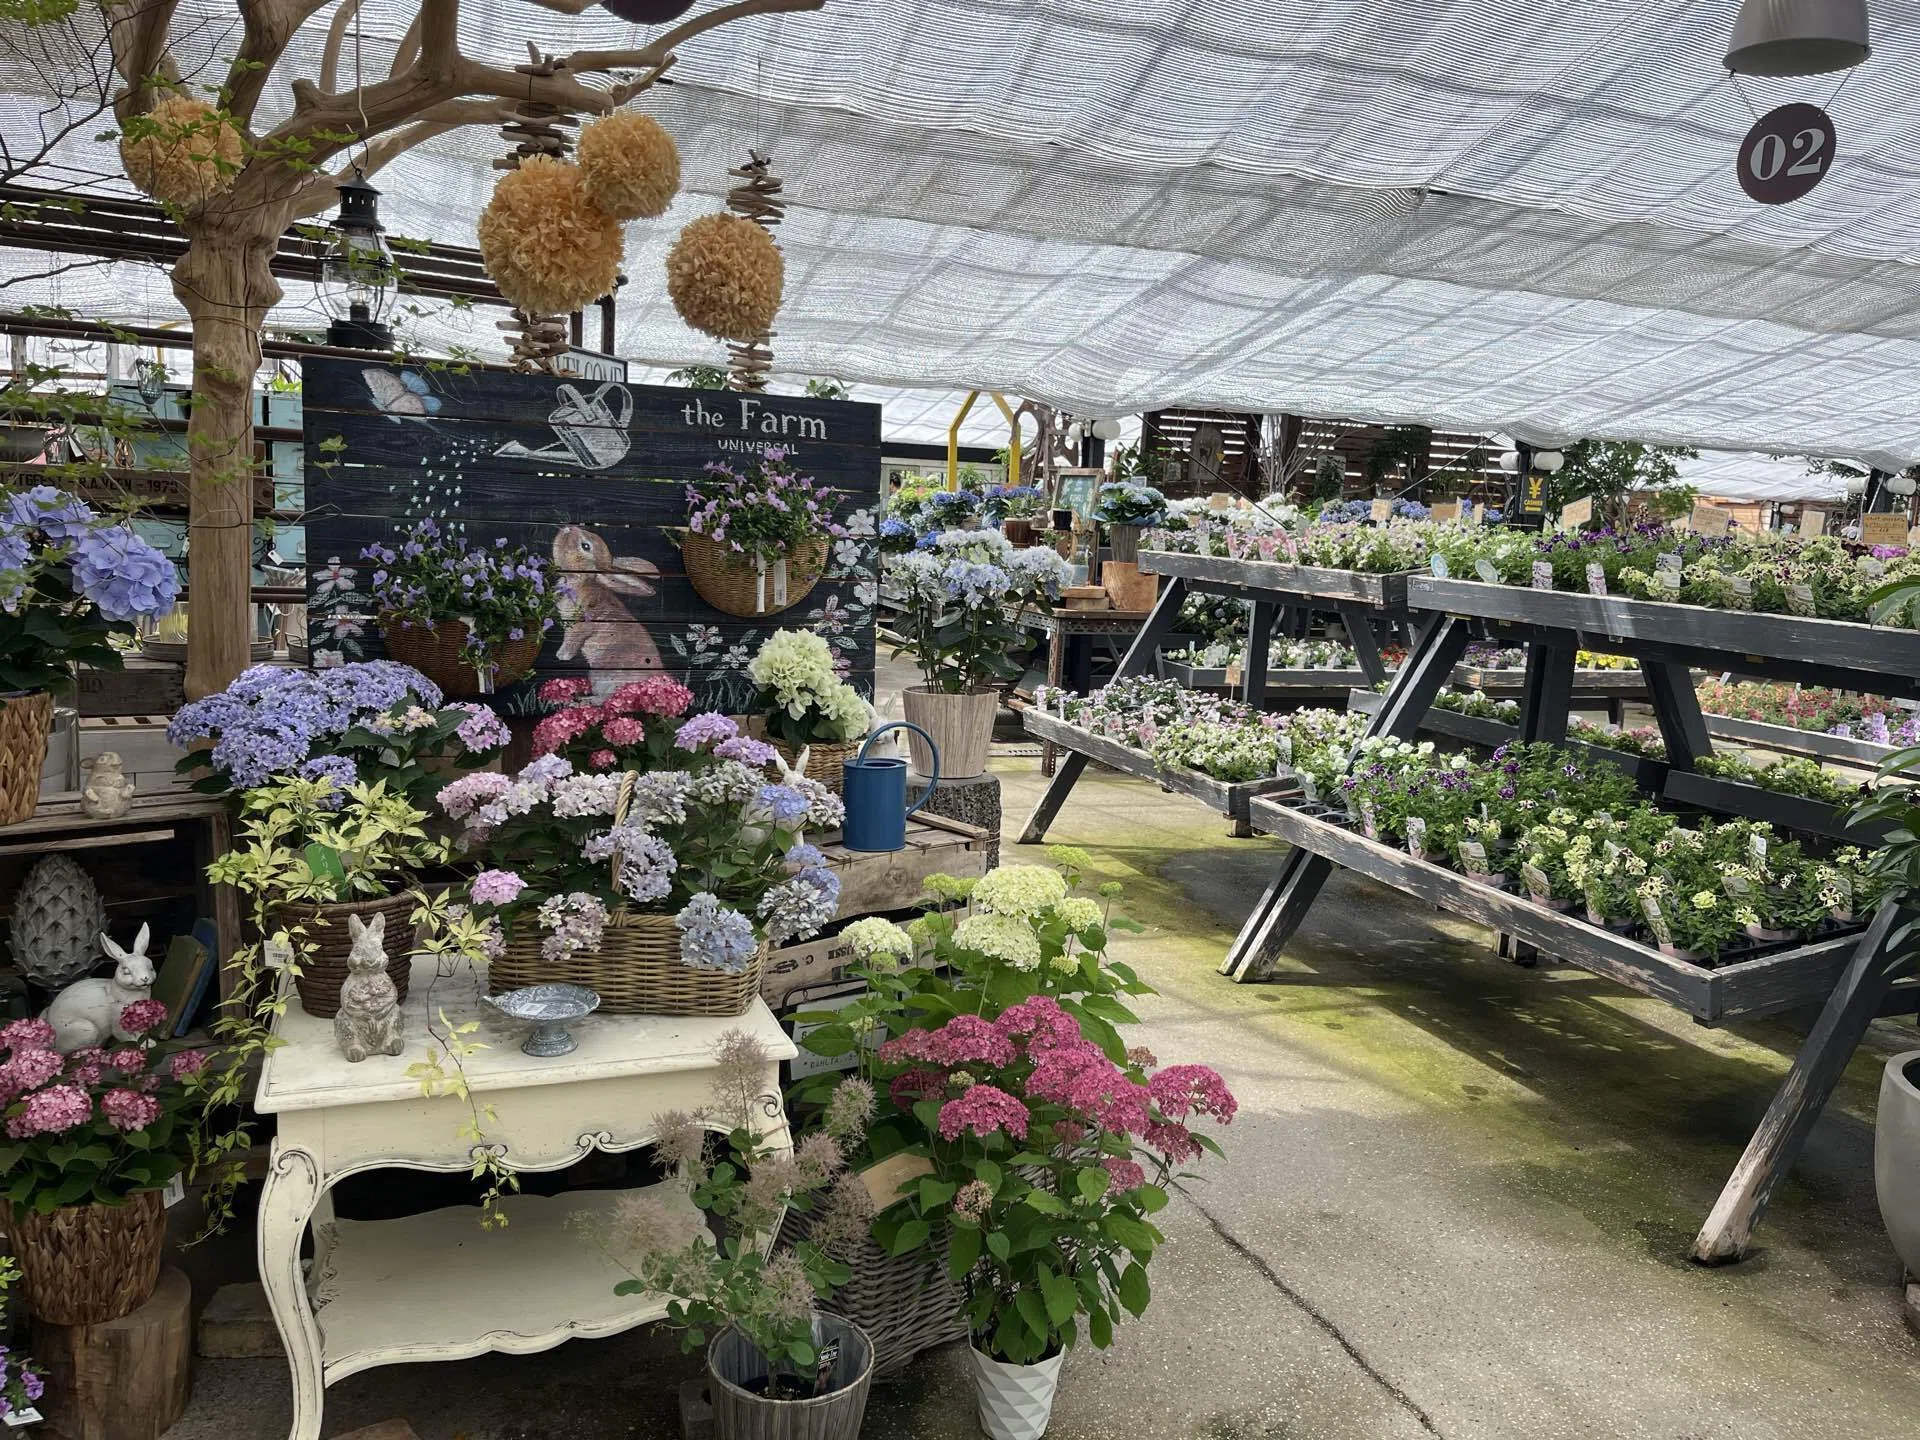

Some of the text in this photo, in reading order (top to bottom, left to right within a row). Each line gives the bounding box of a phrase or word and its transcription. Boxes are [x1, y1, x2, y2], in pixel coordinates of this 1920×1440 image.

[1751, 129, 1825, 180] 02
[680, 398, 828, 440] the Farm
[717, 439, 799, 455] UNIVERSAL
